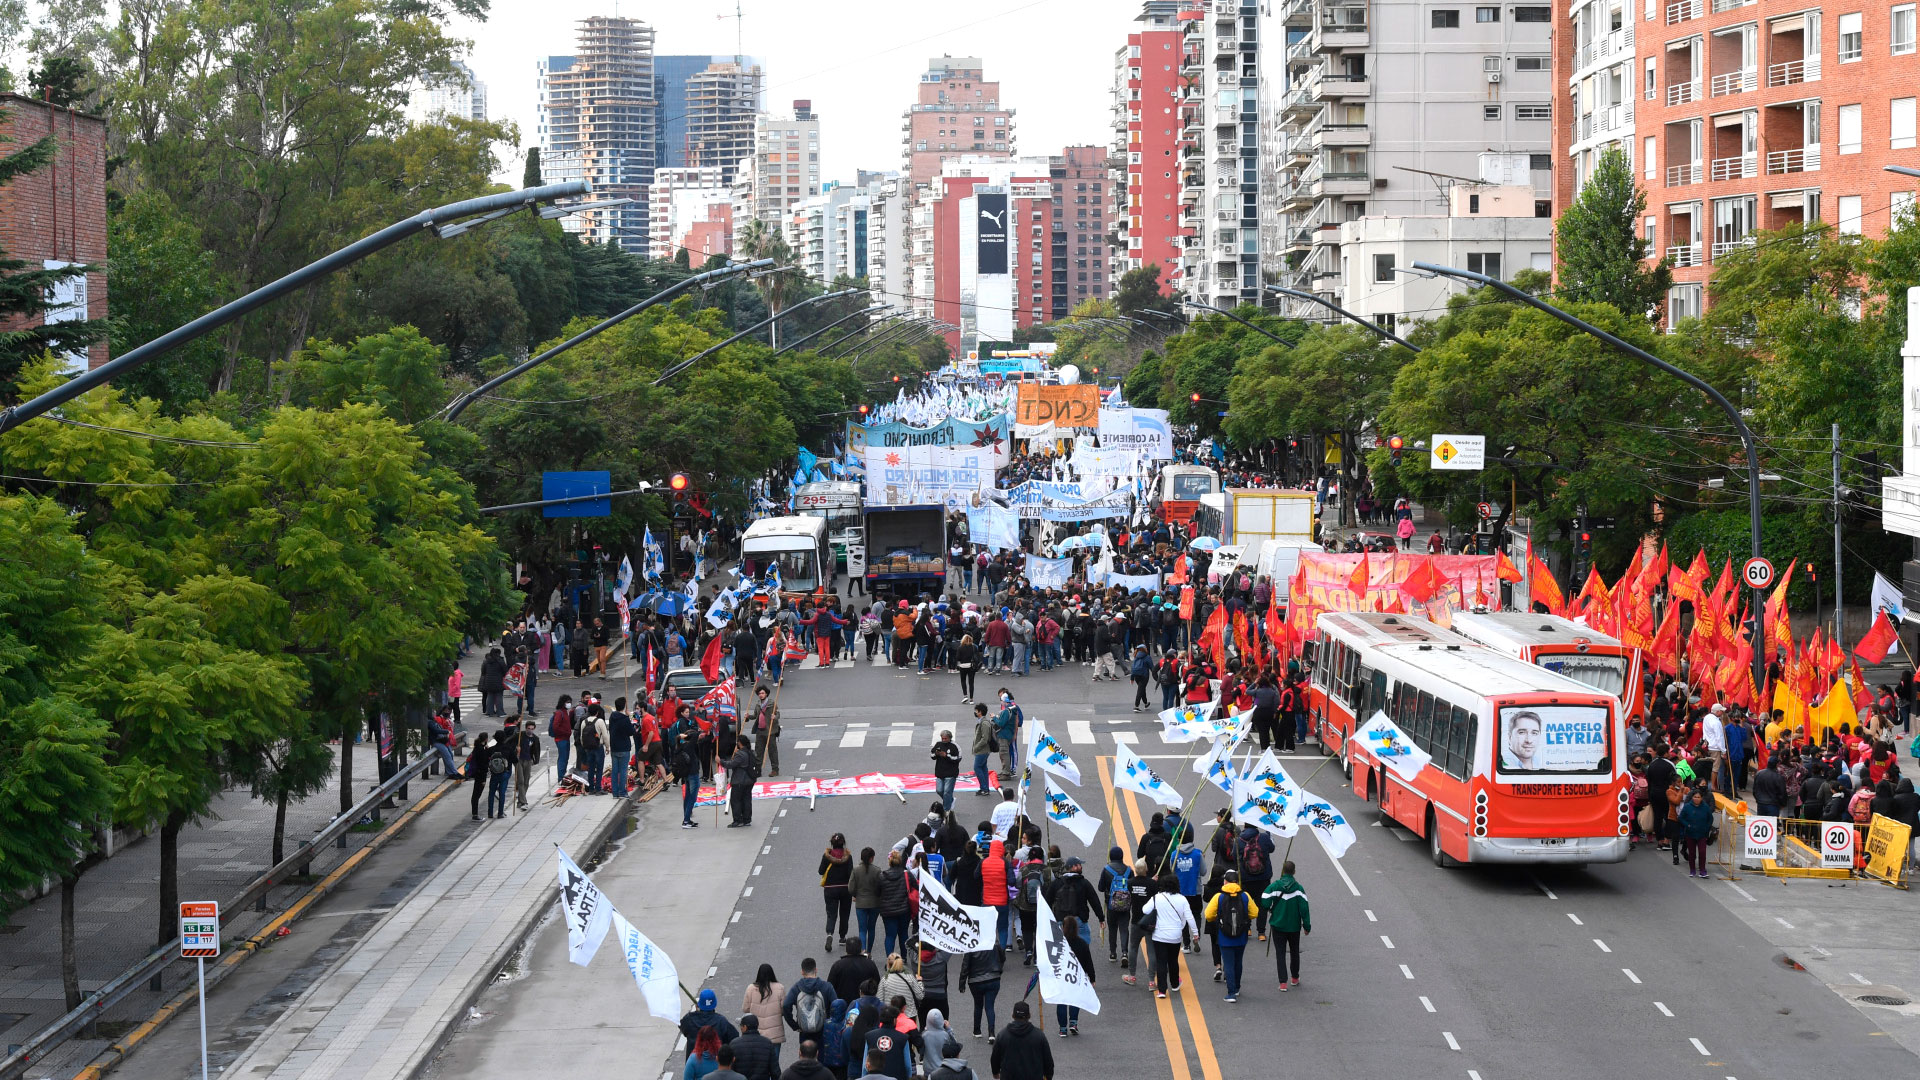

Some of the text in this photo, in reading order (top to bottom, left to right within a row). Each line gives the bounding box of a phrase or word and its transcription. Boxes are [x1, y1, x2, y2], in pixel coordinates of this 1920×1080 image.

[802, 496, 827, 505] 295
[1748, 566, 1768, 580] 60
[1545, 722, 1602, 732] MARCELO
[1545, 732, 1604, 745] LEYRIA
[1511, 784, 1599, 796] TRANSPORTE ESCOLAR
[1753, 825, 1769, 839] 20
[1829, 831, 1845, 845] 20
[1747, 847, 1774, 857] MAXIMA
[1824, 854, 1851, 864] MAXIMA
